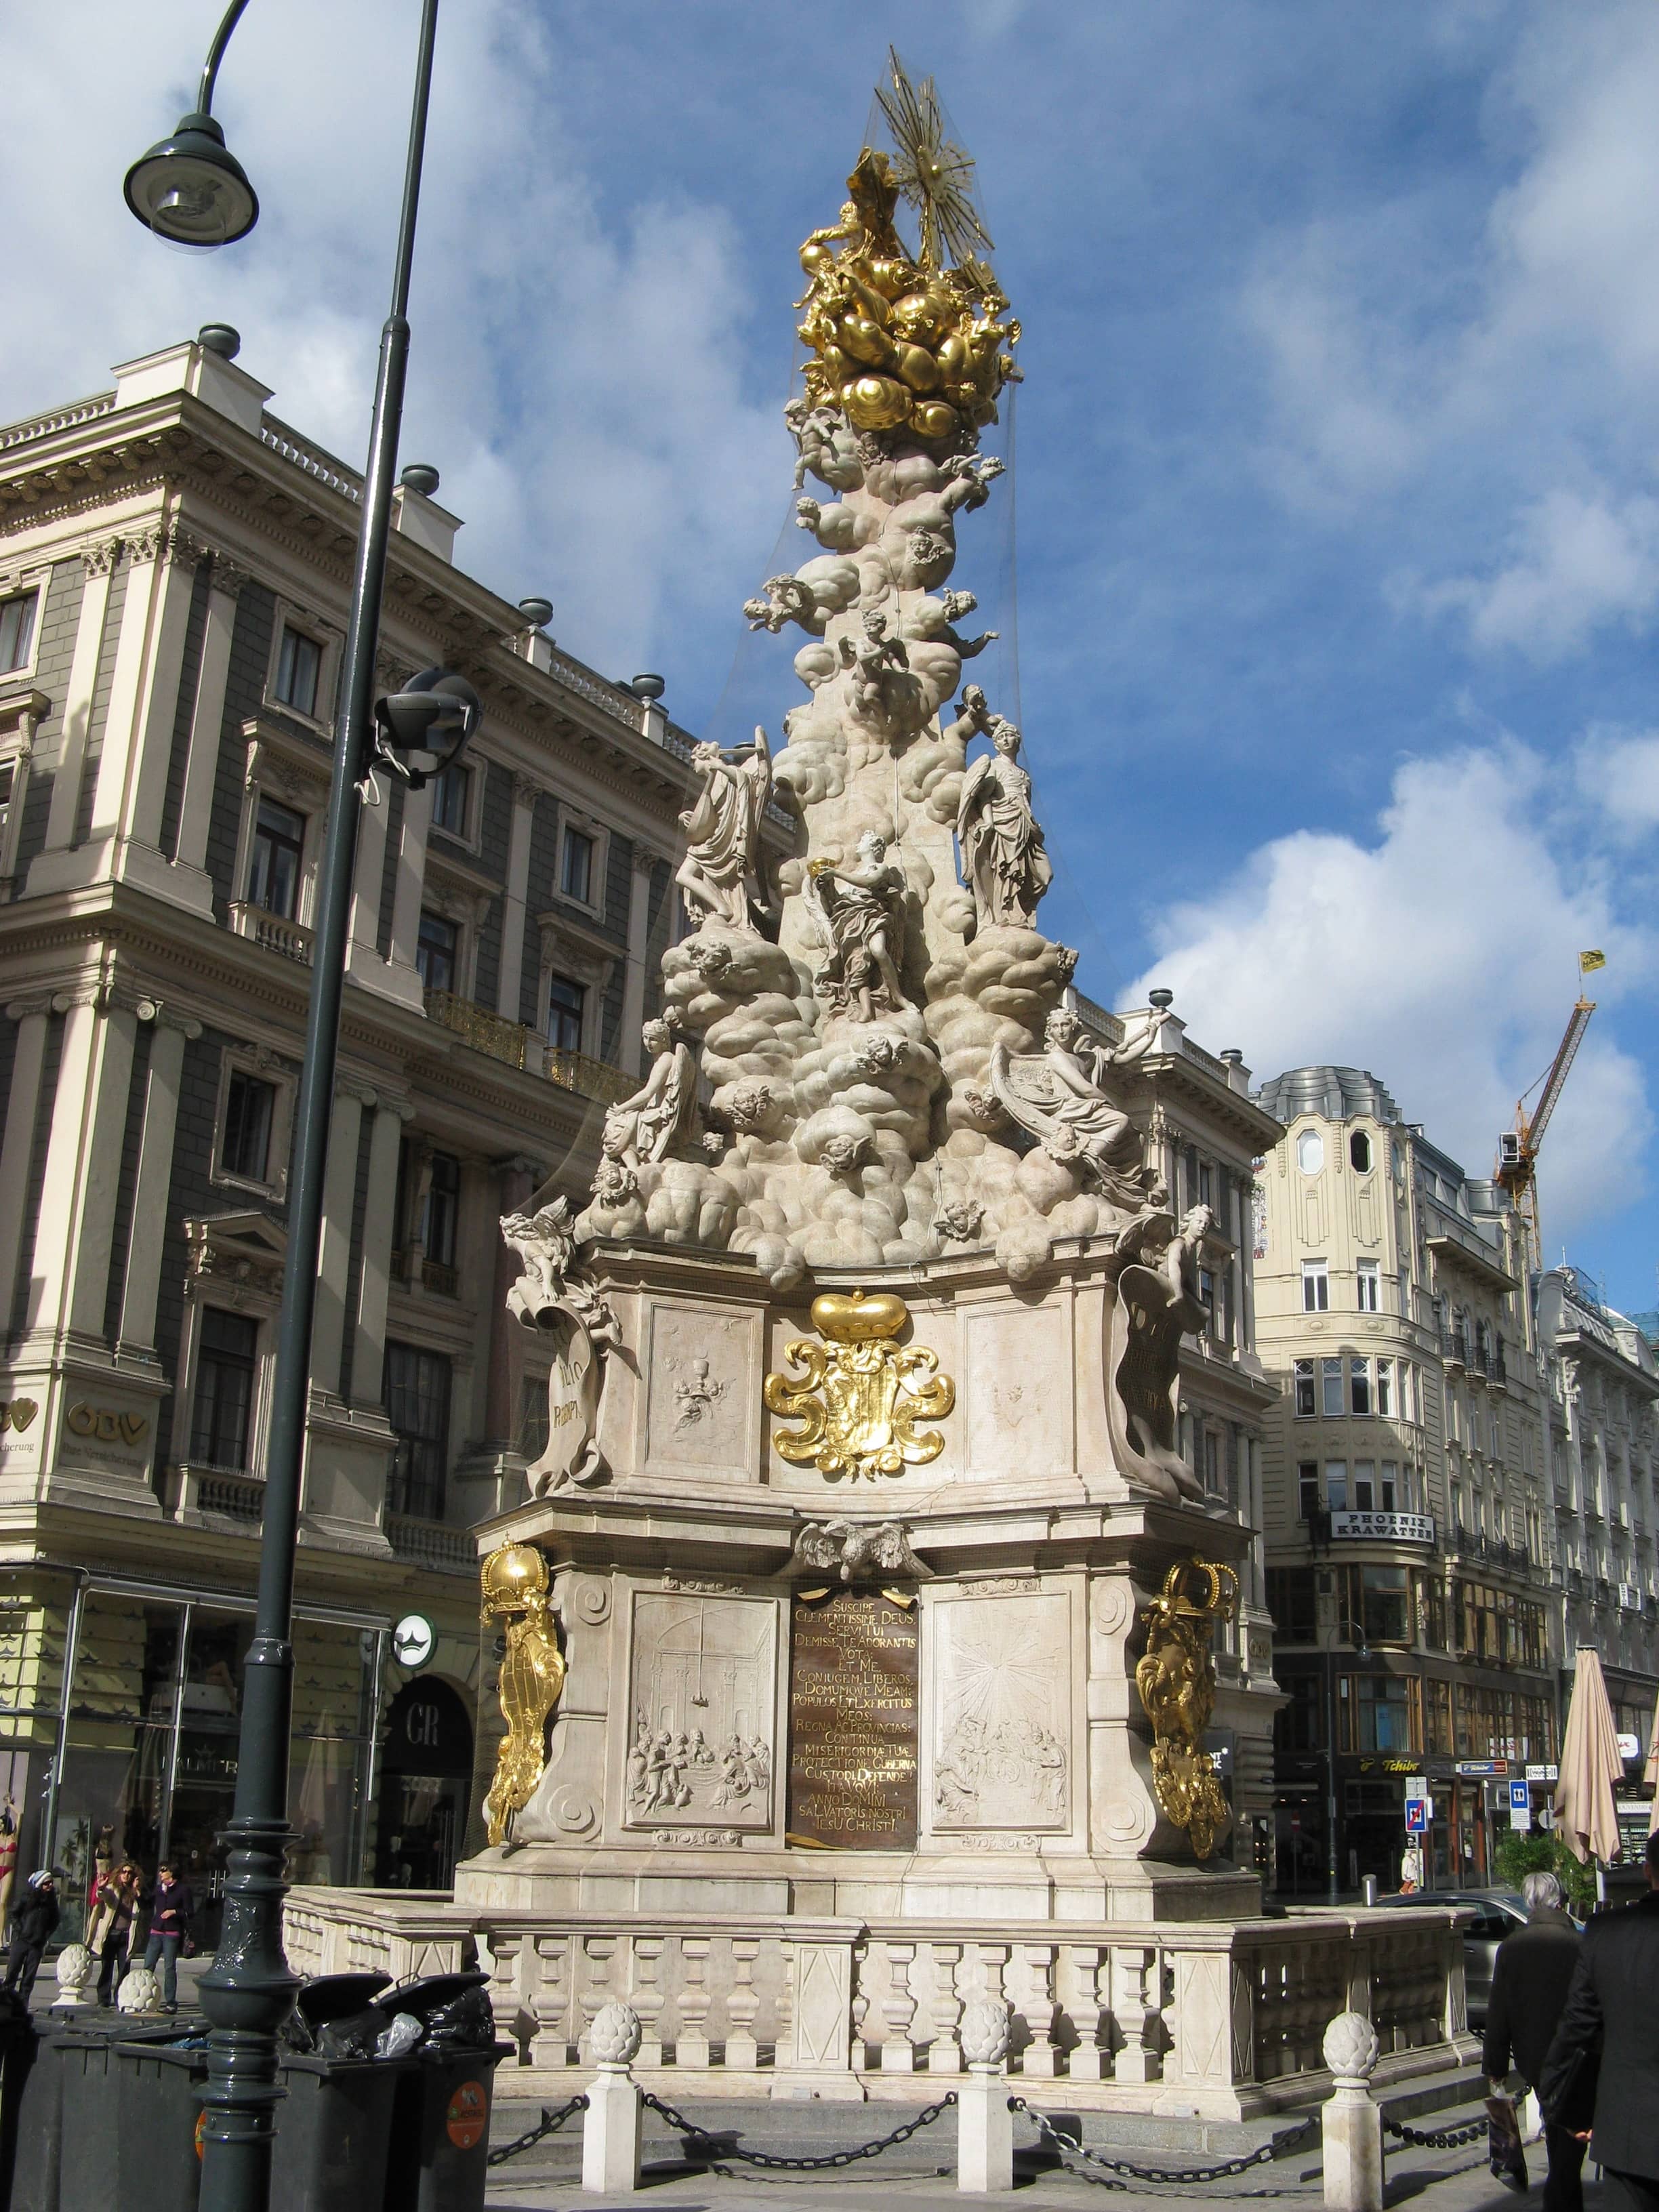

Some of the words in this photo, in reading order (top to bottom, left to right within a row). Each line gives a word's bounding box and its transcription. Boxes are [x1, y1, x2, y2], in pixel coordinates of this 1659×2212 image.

[1349, 1515, 1427, 1528] PHOENIX
[1337, 1525, 1433, 1539] KRAWATTEN
[833, 1599, 875, 1613] SUSCIPE
[795, 1610, 878, 1625] CLEMENTISSIME
[828, 1622, 861, 1635] SERVI
[861, 1624, 884, 1636] TUI
[795, 1633, 838, 1647] DEMISSE
[838, 1634, 856, 1647] TE
[857, 1635, 916, 1649] ADORANTIS
[839, 1659, 855, 1671] ET
[793, 1693, 837, 1707] POPULOS
[839, 1696, 854, 1708] ET
[855, 1696, 912, 1709] EXERCITUS
[407, 1702, 440, 1746] GR
[796, 1719, 832, 1732] REGNA
[836, 1720, 848, 1732] AC
[825, 1731, 884, 1744] CONTINUA
[792, 1754, 871, 1769] PROTECTIONE
[1382, 1760, 1420, 1772] Tchibo
[827, 1779, 846, 1793] ITA
[808, 1793, 840, 1805] ANNO
[842, 1793, 886, 1807] DOMINI
[799, 1804, 866, 1818] SALVATORIS
[869, 1807, 906, 1820] NOSTRI
[817, 1816, 844, 1830] IESU
